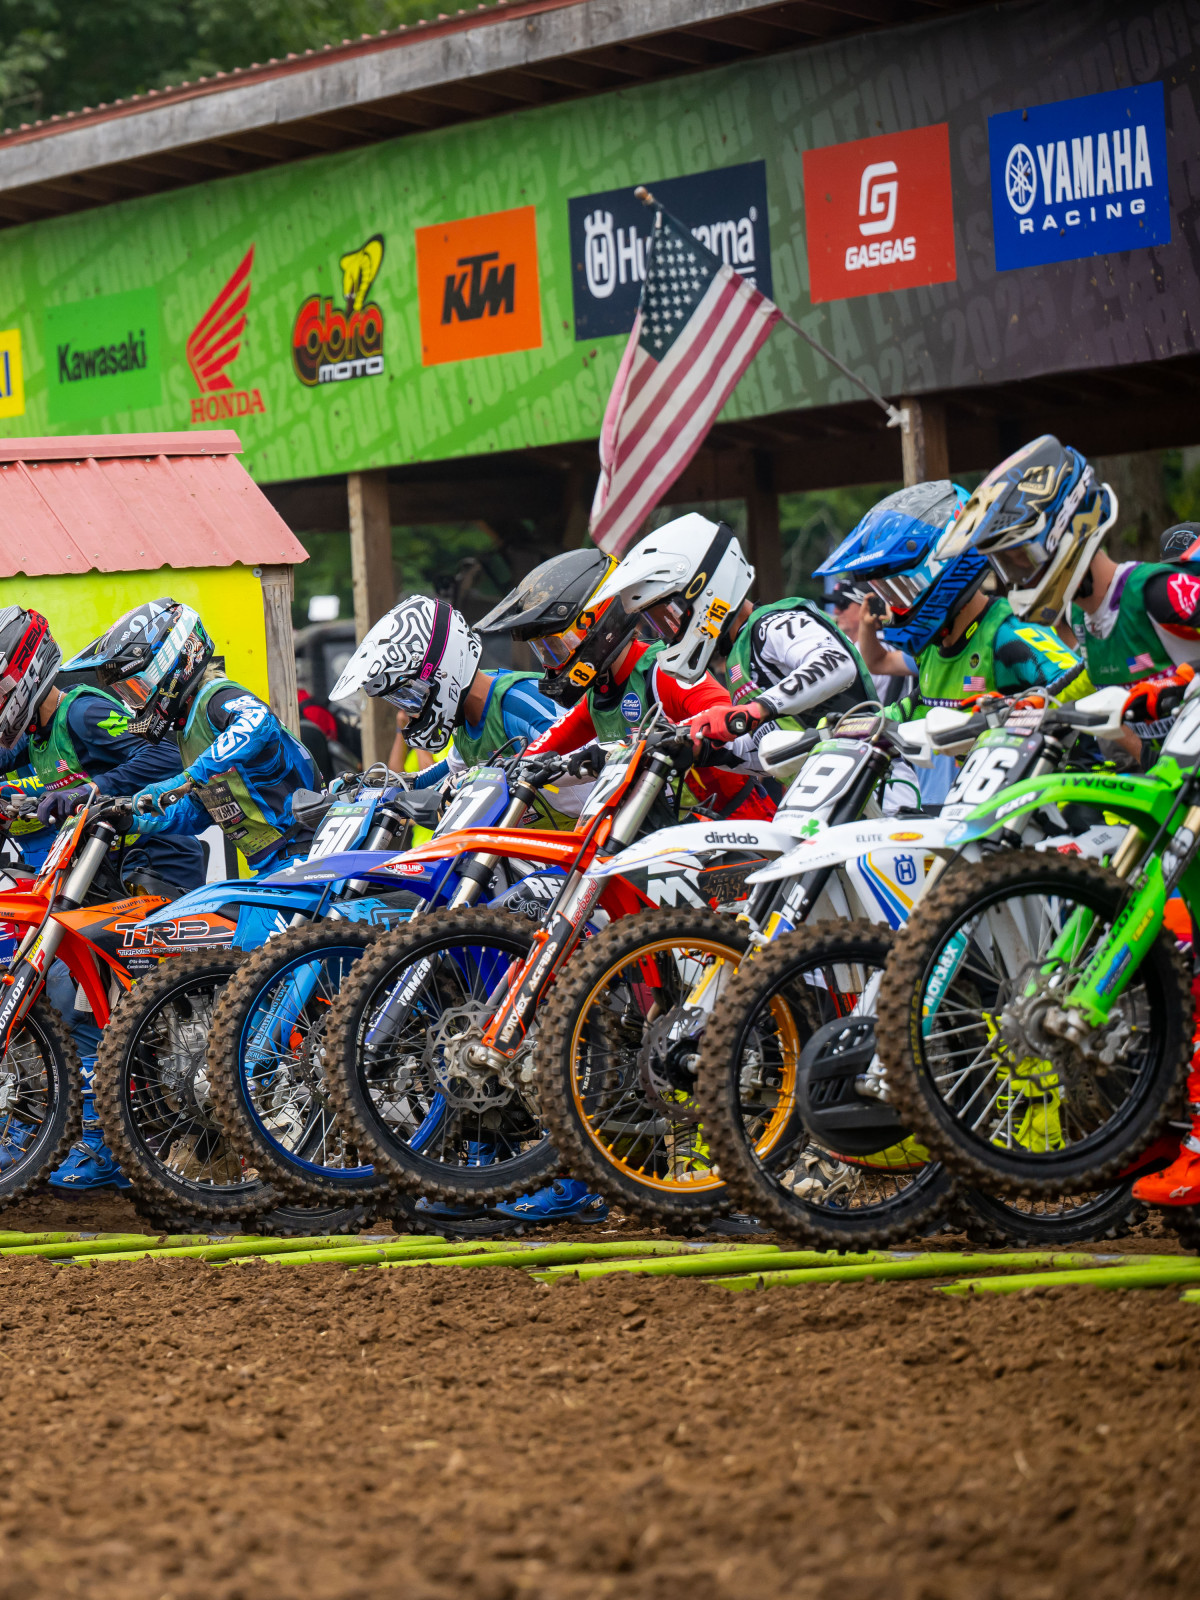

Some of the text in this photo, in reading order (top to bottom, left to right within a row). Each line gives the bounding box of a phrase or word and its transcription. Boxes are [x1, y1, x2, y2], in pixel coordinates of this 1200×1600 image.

[1036, 125, 1153, 205] YAMAHA
[1020, 199, 1146, 234] RACING
[845, 237, 917, 271] GASGAS
[441, 251, 516, 326] KTM
[56, 329, 148, 385] Kawasaki
[293, 294, 384, 386] Cobra
[318, 356, 384, 384] MOTO
[190, 389, 266, 424] HONDA
[709, 602, 729, 621] 15
[6, 648, 49, 724] BELL
[574, 667, 591, 682] 8
[944, 747, 1020, 805] 96
[307, 816, 364, 862] 50
[498, 836, 574, 853] PERFORMANCE
[704, 831, 759, 845] dirtlab
[115, 920, 210, 948] TRP
[397, 957, 433, 1007] TAMER
[923, 944, 959, 1008] MOTOREX
[499, 992, 533, 1044] MOTOREX
